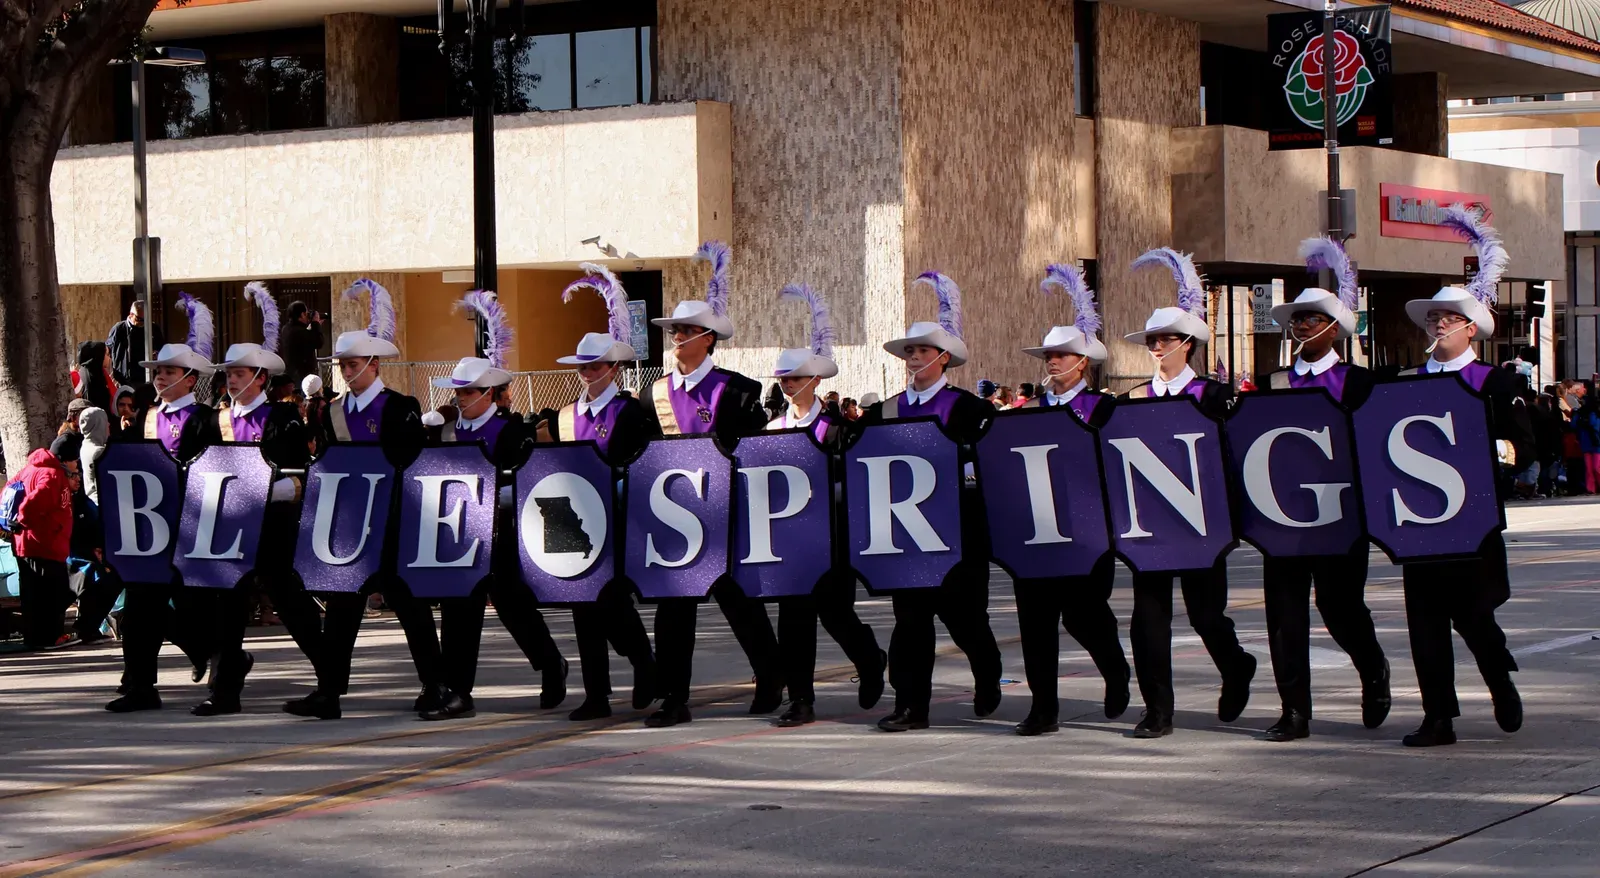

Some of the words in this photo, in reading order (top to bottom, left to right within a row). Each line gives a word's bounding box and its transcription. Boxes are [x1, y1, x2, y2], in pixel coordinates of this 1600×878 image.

[1272, 20, 1317, 67] ROSE
[1335, 15, 1390, 75] PARADE
[1390, 196, 1420, 223] Bank
[107, 470, 479, 568] BLUE
[645, 411, 1466, 568] SPRINGS
